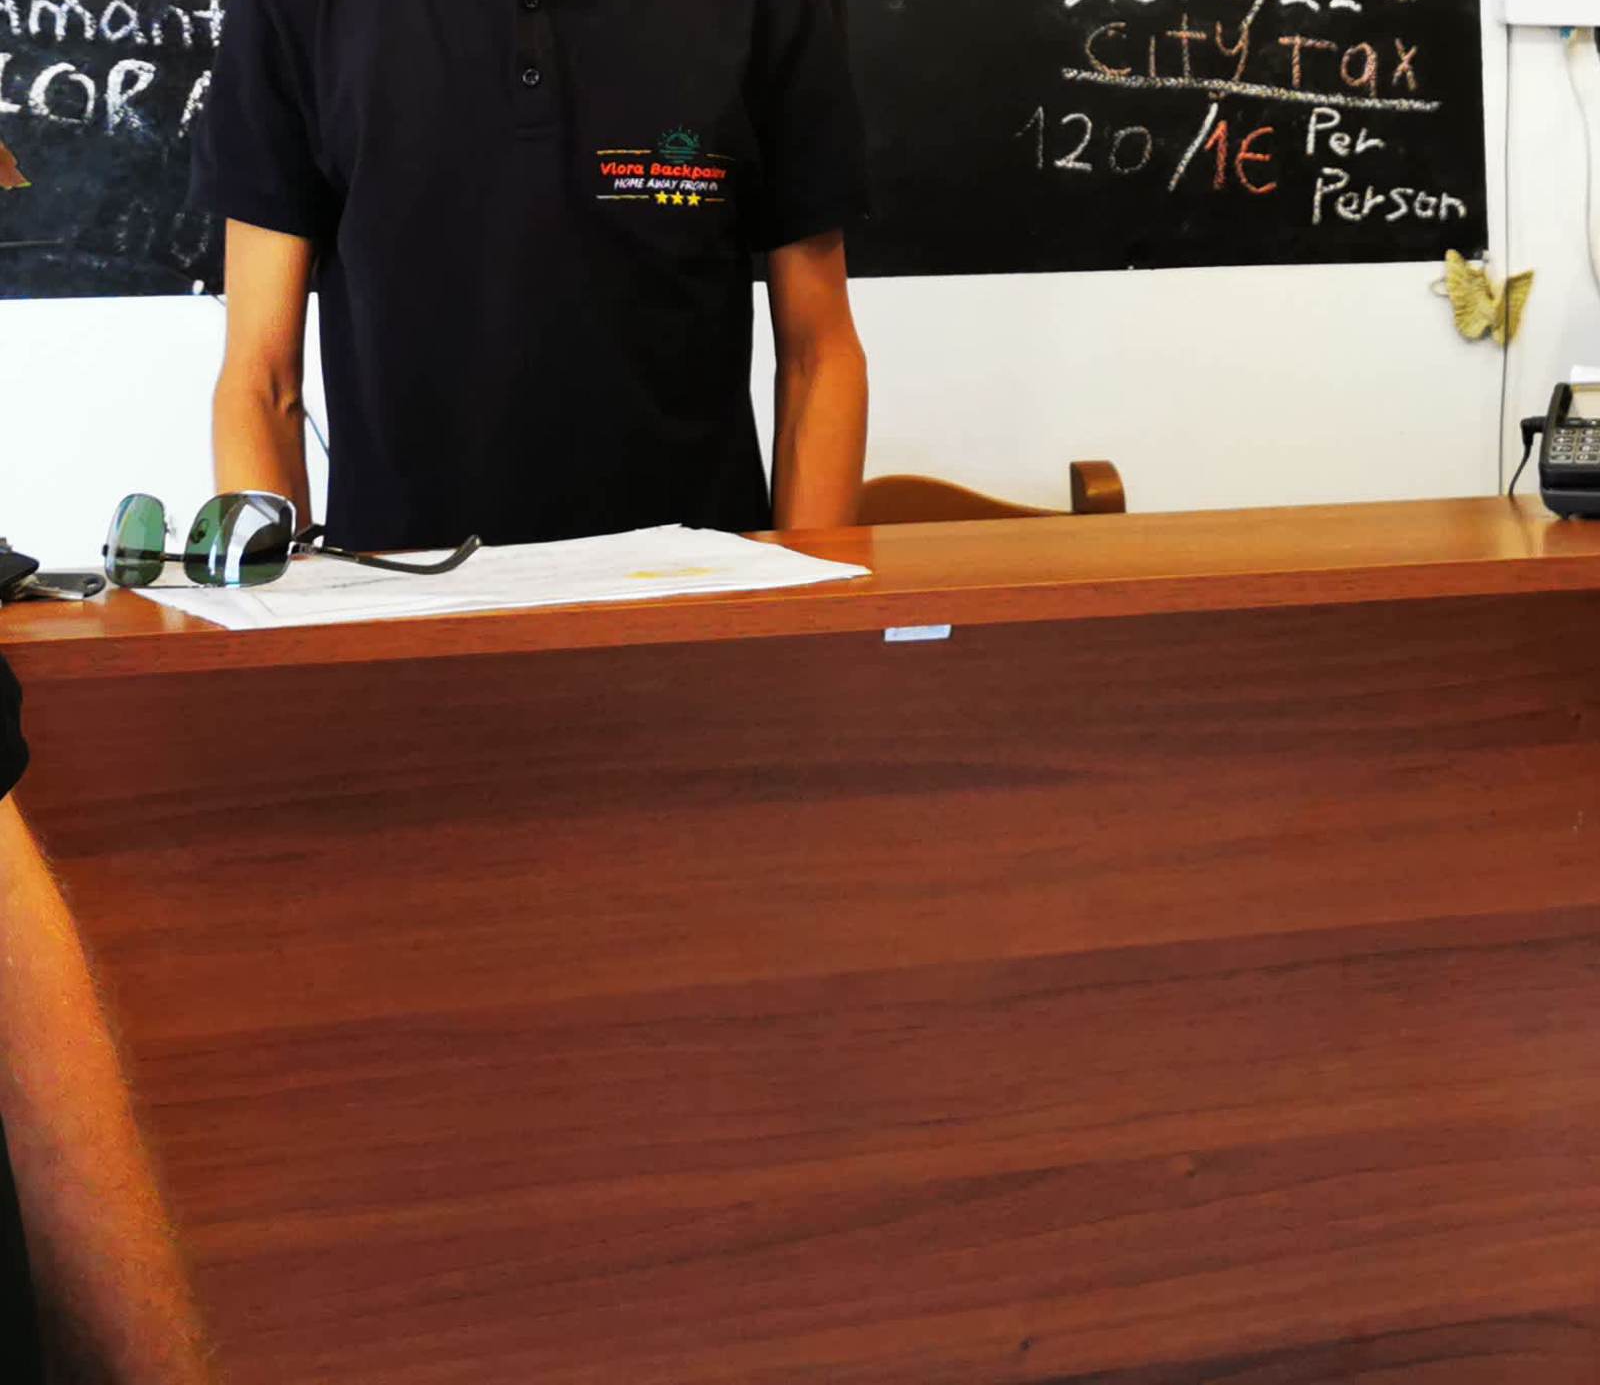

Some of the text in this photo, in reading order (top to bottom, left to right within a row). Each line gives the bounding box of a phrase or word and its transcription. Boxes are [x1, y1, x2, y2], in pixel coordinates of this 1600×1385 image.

[601, 162, 645, 176] Vlora
[613, 177, 646, 191] HOME
[1311, 167, 1468, 226] Person
